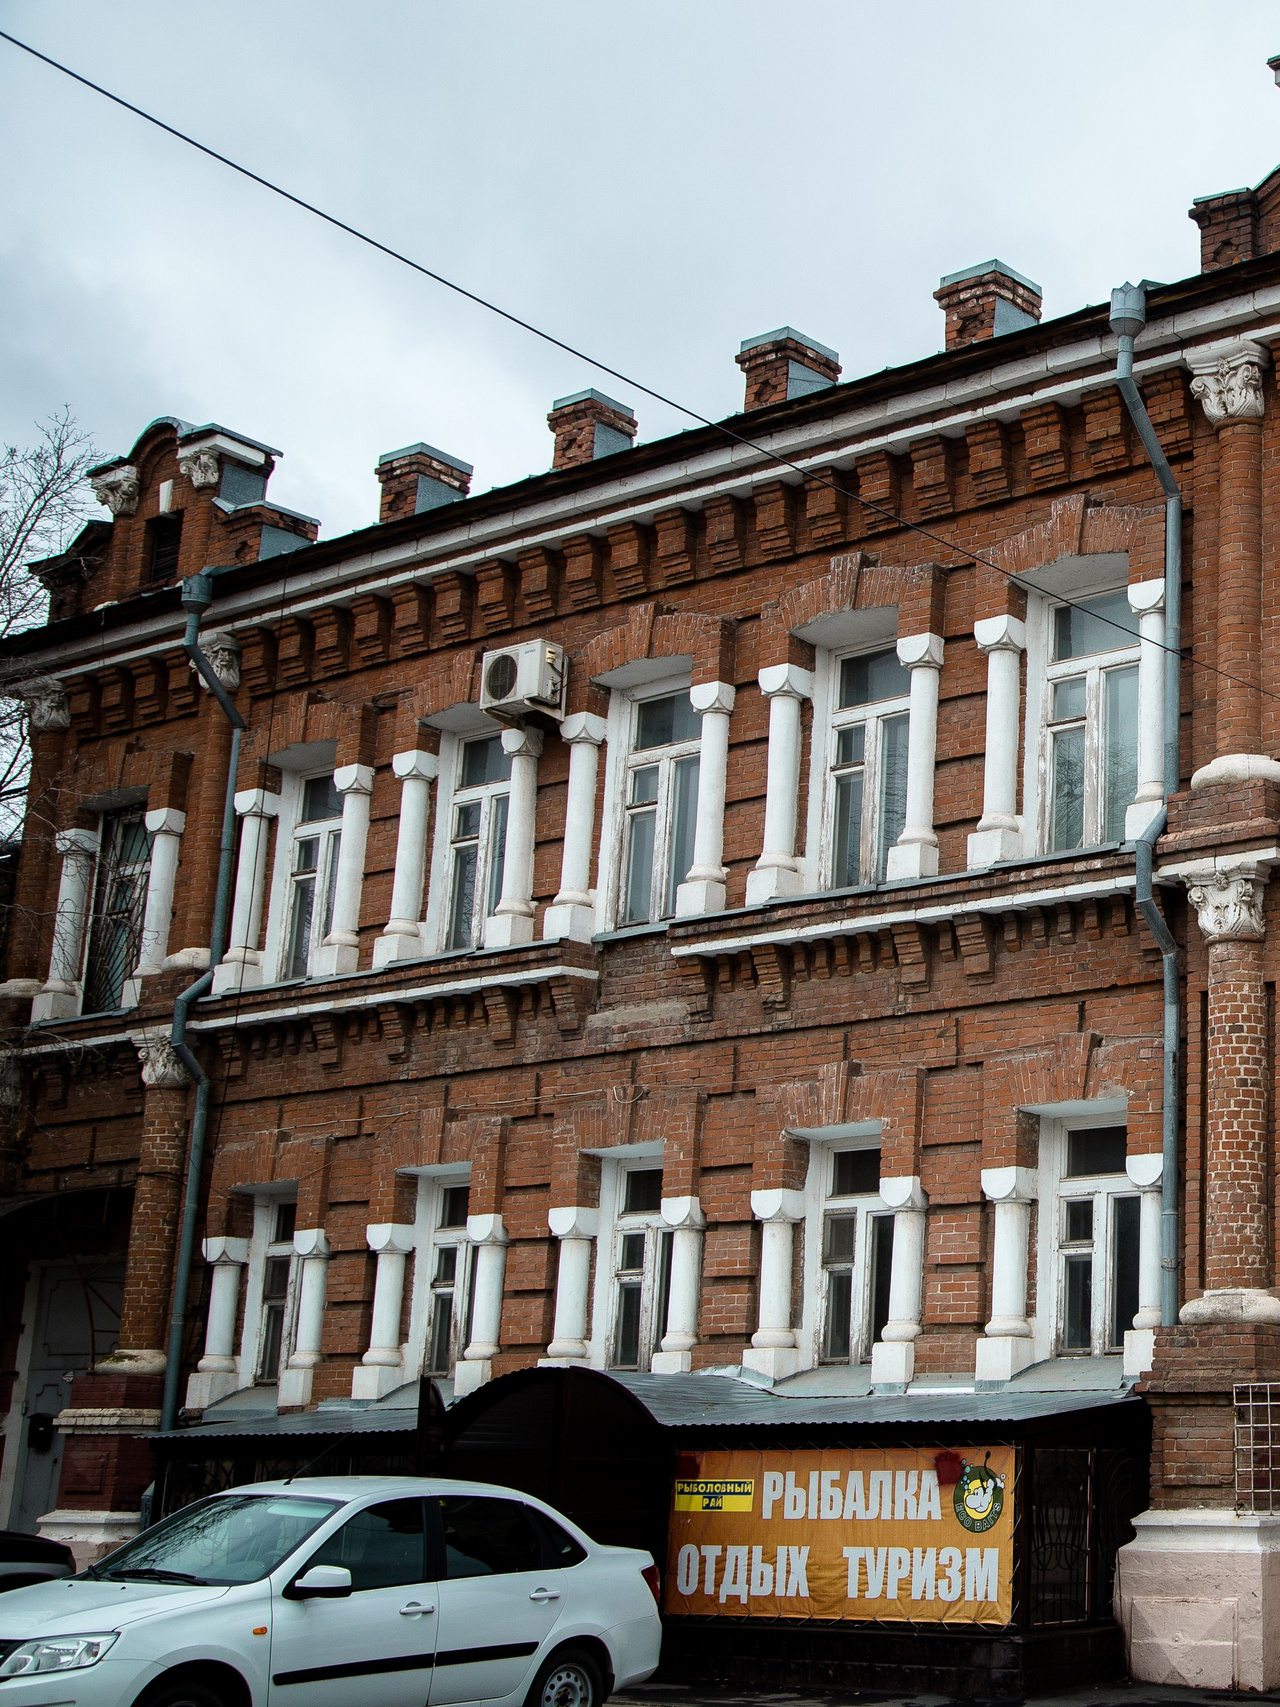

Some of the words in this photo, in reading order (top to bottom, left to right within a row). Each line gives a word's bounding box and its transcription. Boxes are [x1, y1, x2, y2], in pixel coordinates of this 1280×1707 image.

[677, 1481, 752, 1493] РЫБОЛОВНЫЙ
[702, 1496, 722, 1507] РАЙ
[762, 1470, 942, 1520] РЫБАЛКА
[955, 1503, 972, 1527] ECO
[974, 1502, 1001, 1531] BAITS
[676, 1543, 810, 1604] ОТДЫХ
[843, 1546, 999, 1602] ТУРИЗМ
